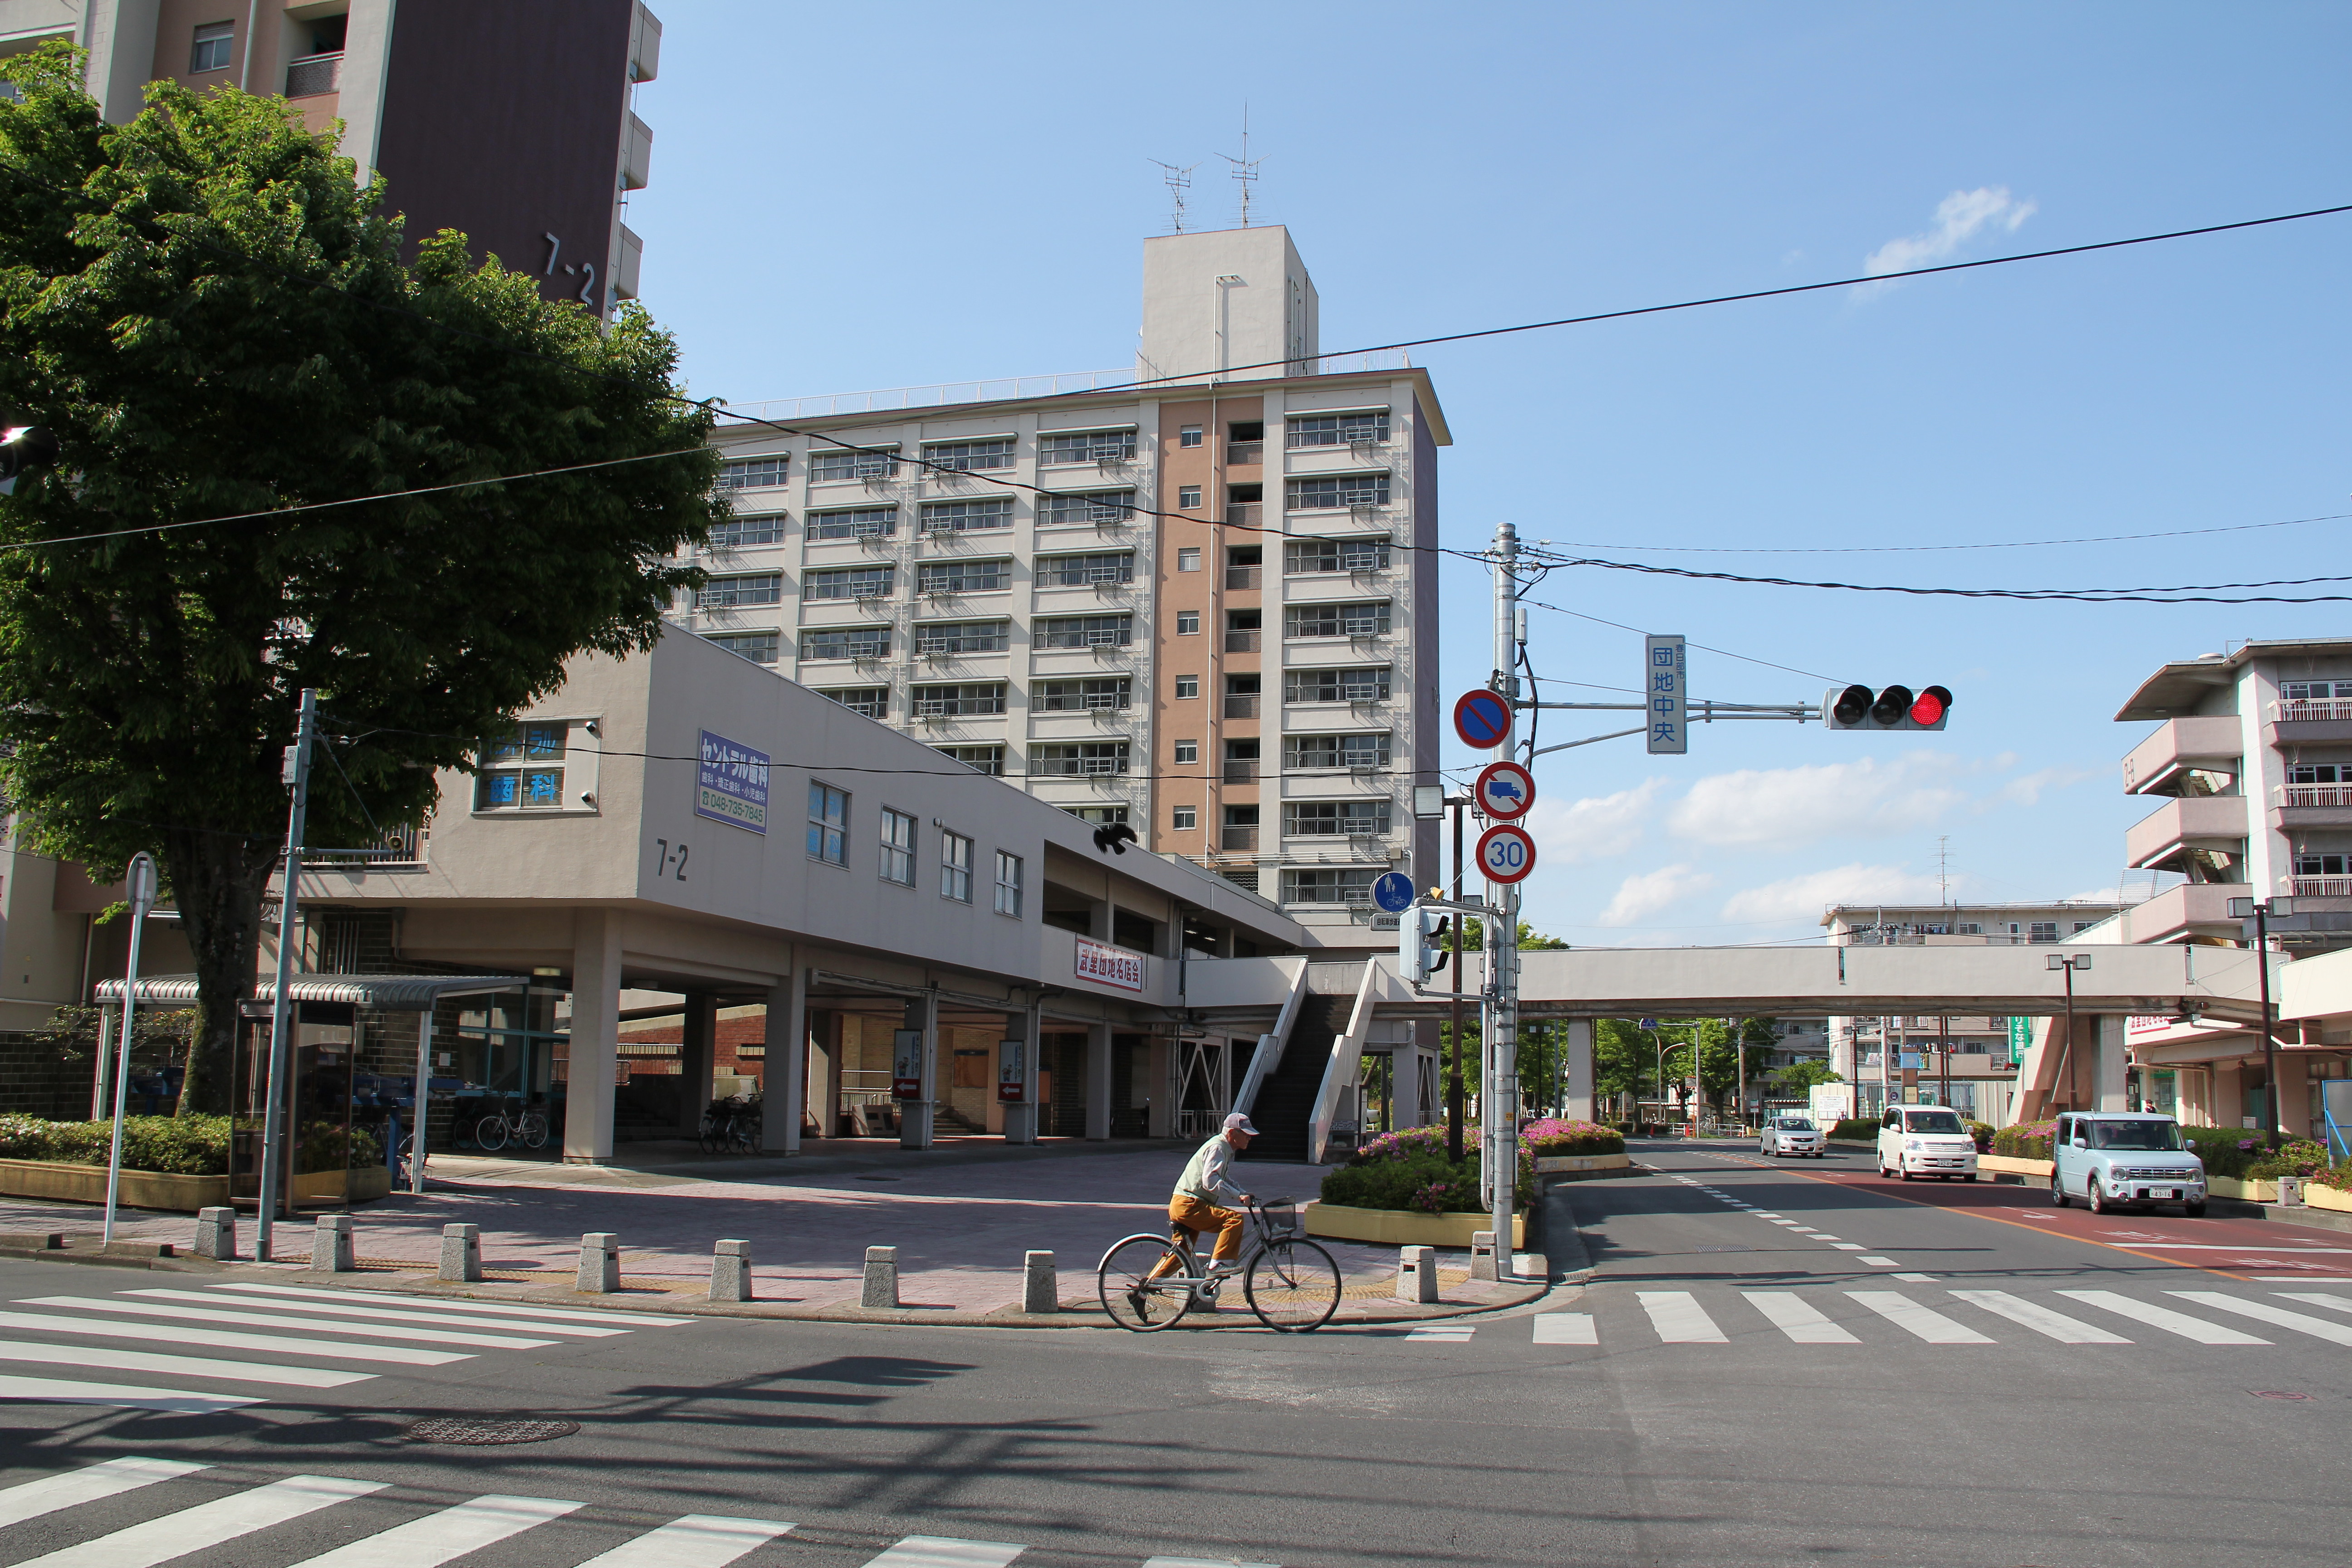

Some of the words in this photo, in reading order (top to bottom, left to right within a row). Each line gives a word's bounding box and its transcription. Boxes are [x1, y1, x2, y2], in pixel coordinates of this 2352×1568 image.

[545, 231, 594, 306] 7-2
[1676, 644, 1685, 679] 春日部市
[1653, 647, 1675, 742] 団地中央
[701, 738, 768, 788] セントラル歯科
[711, 794, 763, 823] 048-735-7845
[657, 838, 689, 882] 7-2
[1490, 841, 1523, 867] 30
[1079, 948, 1139, 983] 武里団地名店会
[2014, 1016, 2024, 1058] りそな銀行
